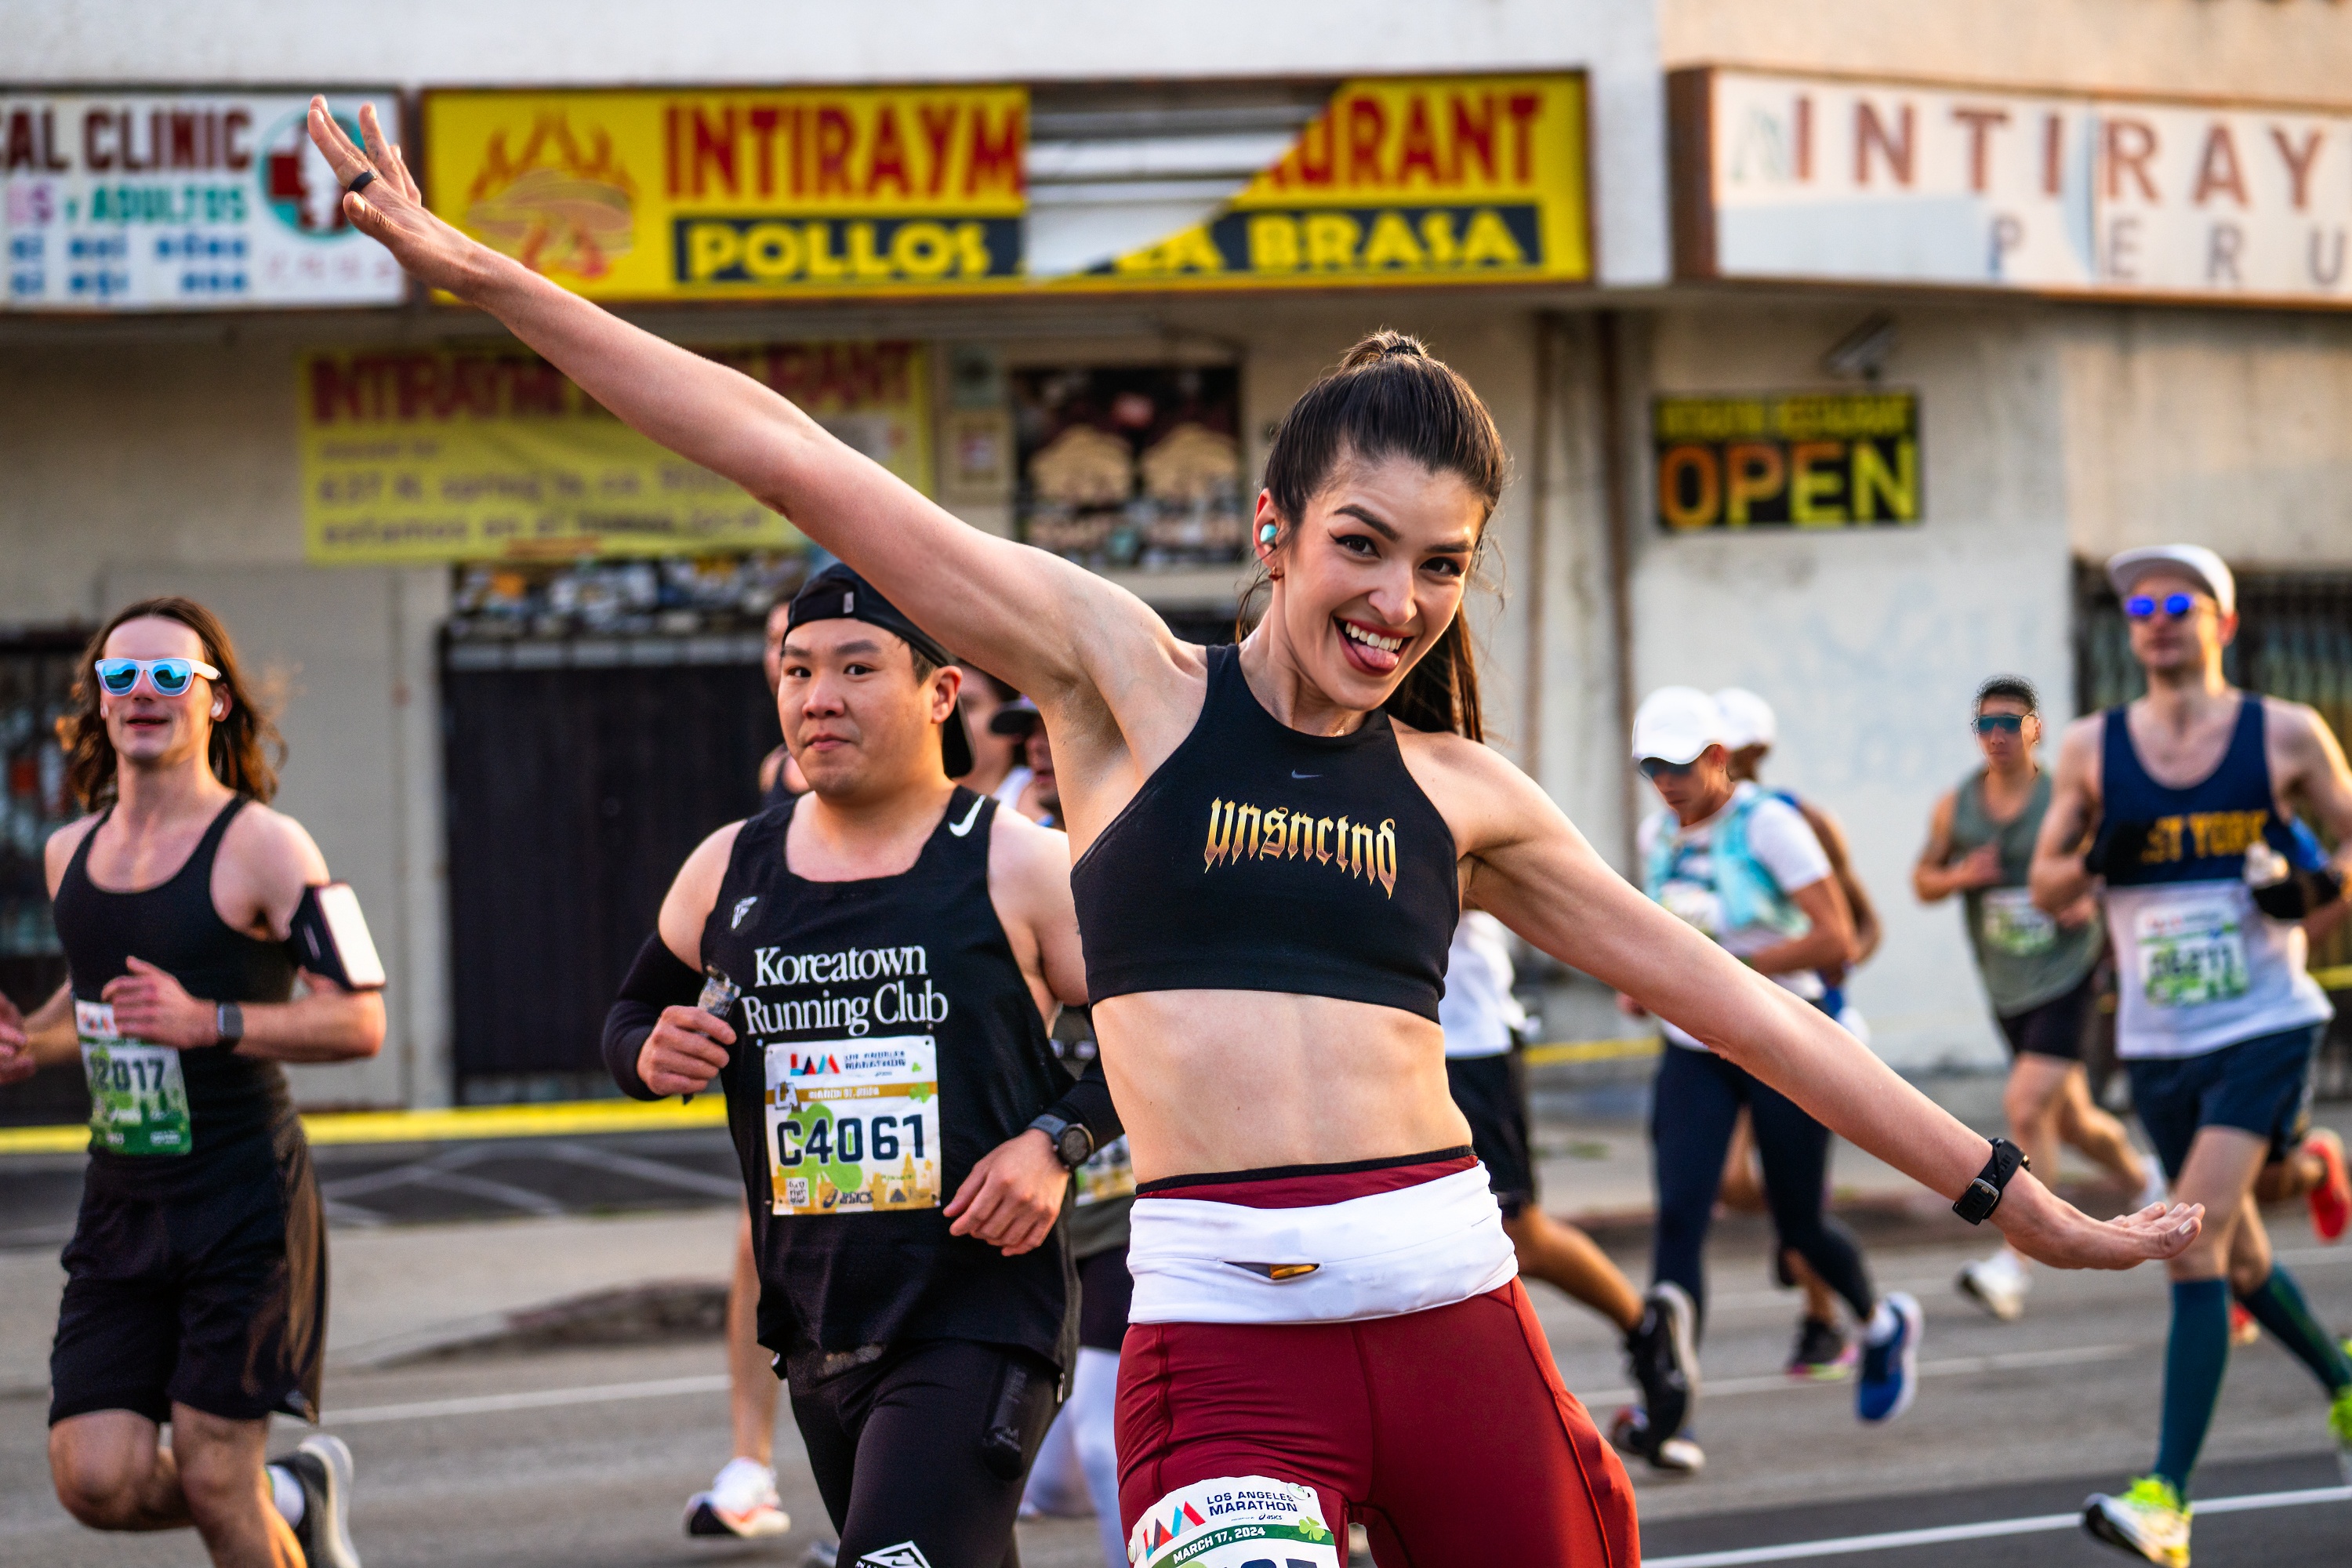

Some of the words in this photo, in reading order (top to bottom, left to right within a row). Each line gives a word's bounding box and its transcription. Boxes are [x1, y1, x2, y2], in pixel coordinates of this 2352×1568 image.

[83, 108, 252, 172] CLINIC
[688, 223, 991, 279] POLLOS
[1250, 212, 1523, 270] BRASA
[1990, 215, 2347, 289] PERU
[1657, 440, 1916, 534] OPEN
[753, 945, 928, 988] Koreatown
[741, 989, 871, 1036] Running
[873, 979, 949, 1025] Club
[776, 1113, 925, 1167] C4061
[1207, 1493, 1232, 1504] LOS
[1209, 1501, 1298, 1516] MARATHON
[1173, 1536, 1214, 1564] MARCH
[1214, 1531, 1232, 1542] 17,
[1234, 1526, 1266, 1538] 2024
